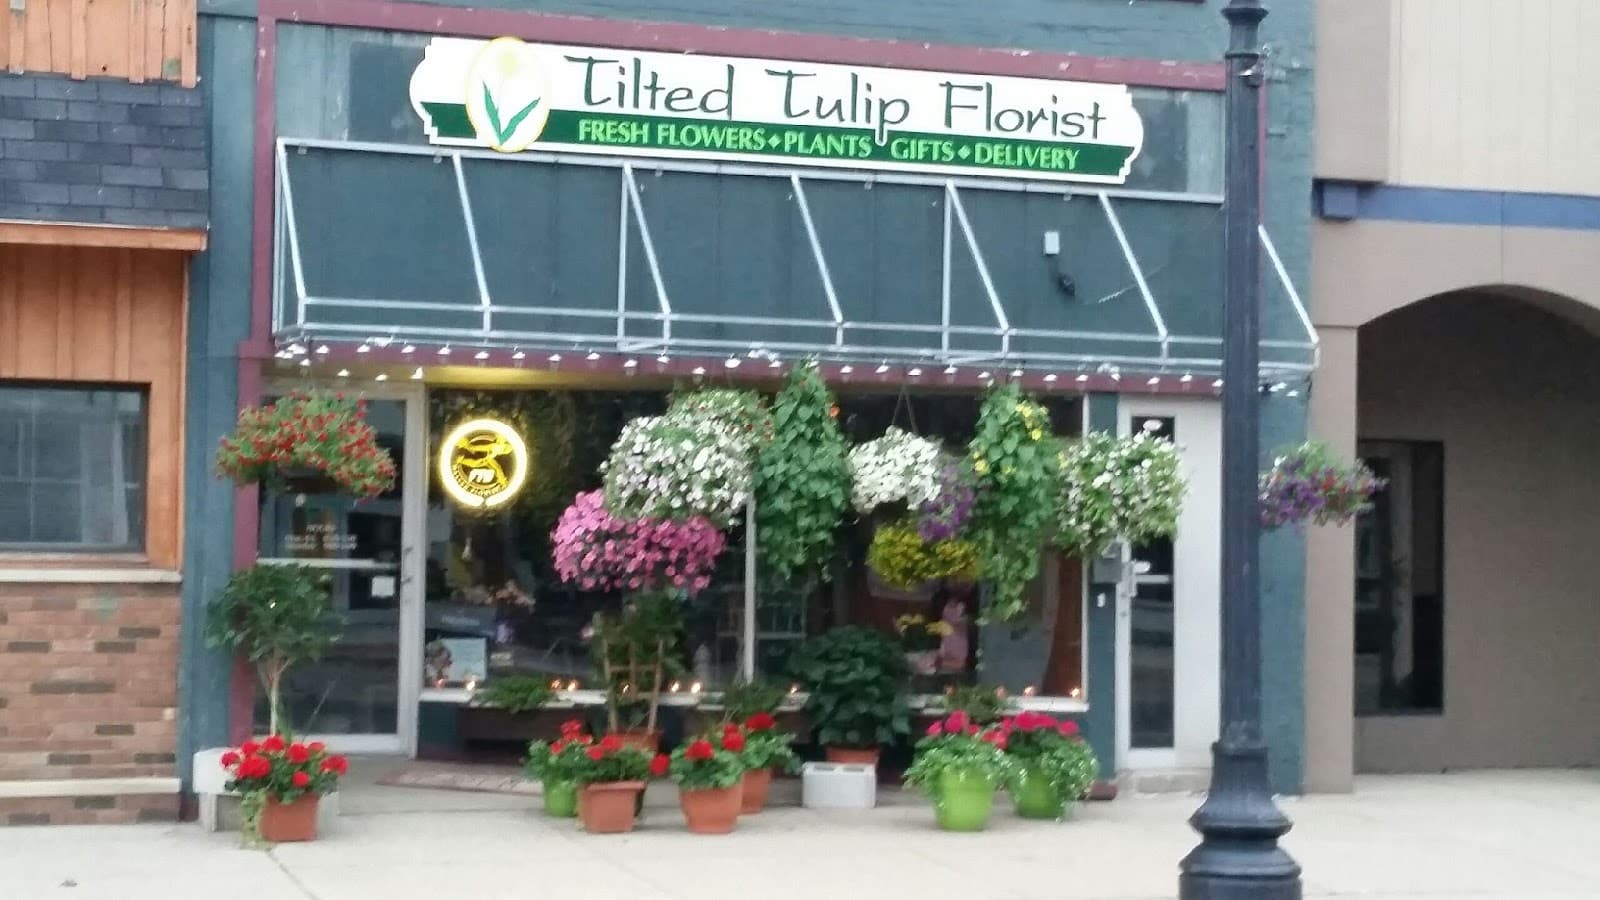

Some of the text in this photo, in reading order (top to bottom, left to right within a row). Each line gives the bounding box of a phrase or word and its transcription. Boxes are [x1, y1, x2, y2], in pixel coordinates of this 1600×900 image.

[564, 55, 1106, 142] Tilted Tulip Florist
[578, 118, 1081, 170] FRESH FLOWERS PLANTS GIFTS DELIVERY
